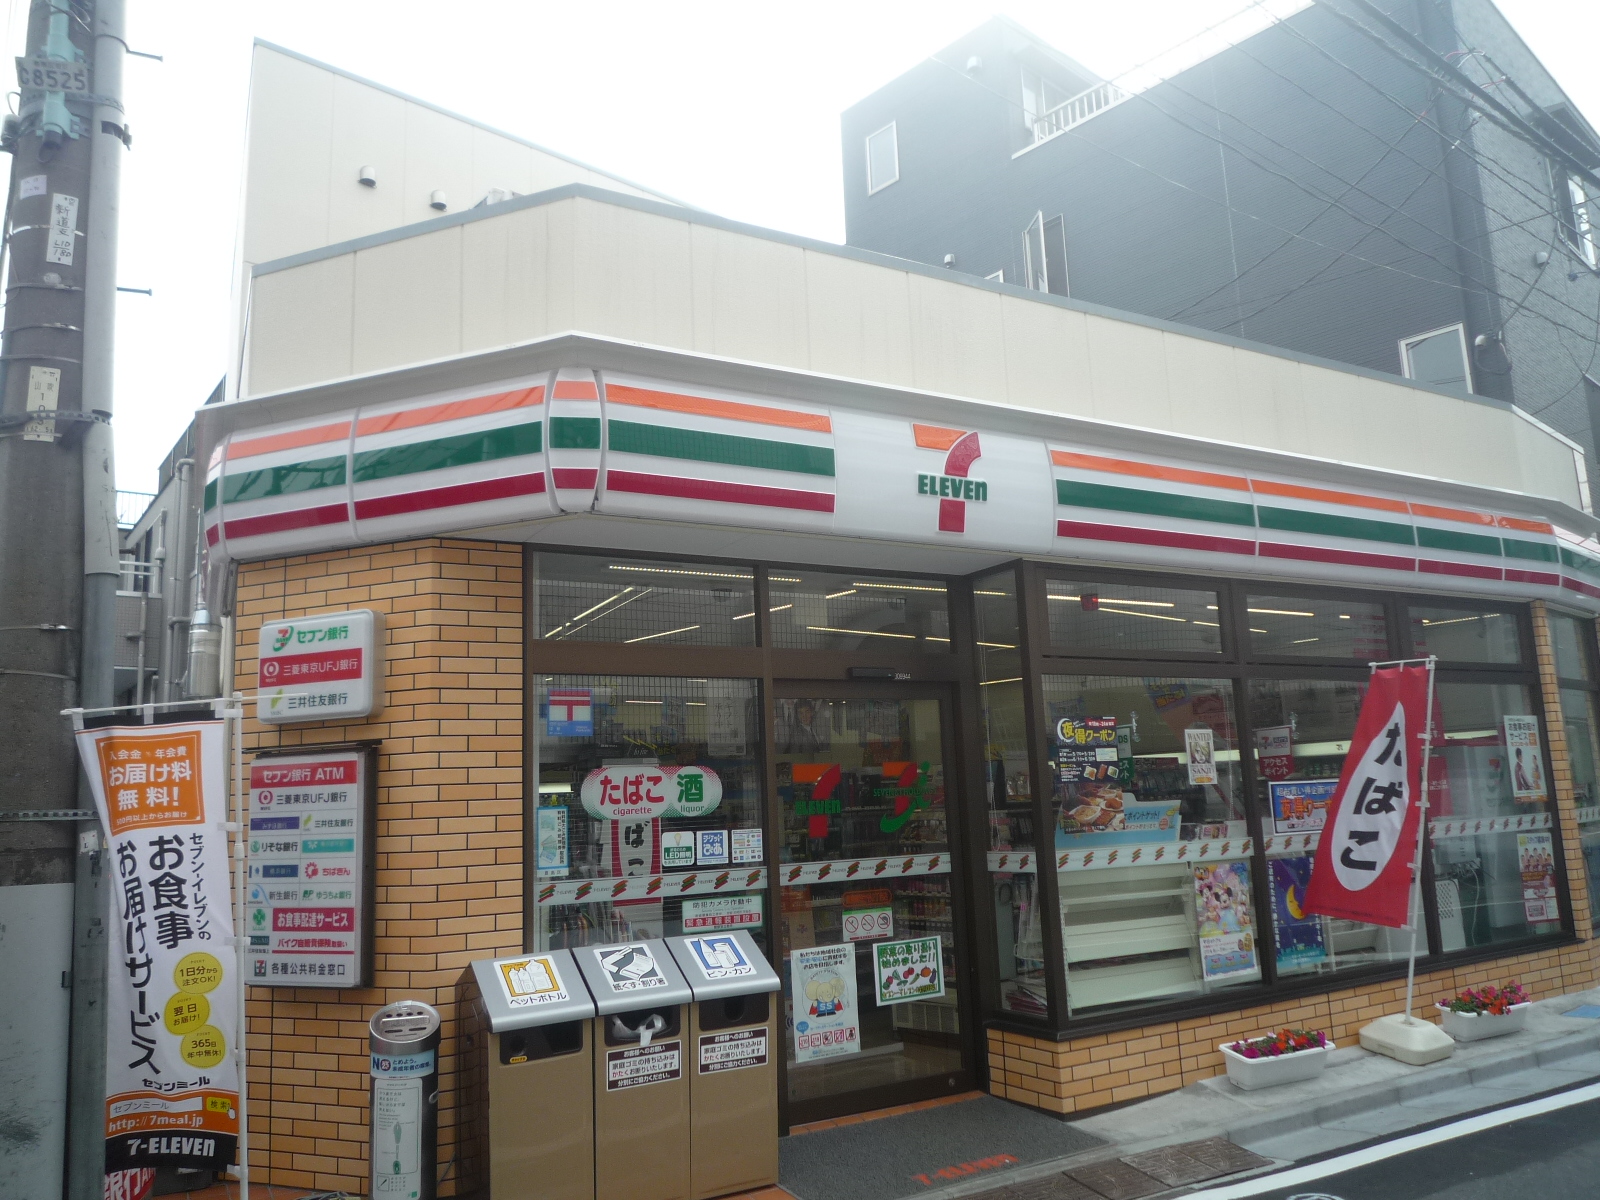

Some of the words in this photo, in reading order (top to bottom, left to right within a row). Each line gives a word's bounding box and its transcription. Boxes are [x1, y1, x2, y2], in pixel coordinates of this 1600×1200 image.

[917, 473, 988, 501] ELEVEN
[297, 625, 349, 644] セブン銀行
[283, 658, 358, 676] 三菱東京UFJ銀行
[288, 693, 348, 709] 三井住友銀行
[1263, 757, 1288, 766] アクセス
[109, 759, 192, 787] お届け料
[262, 768, 312, 784] セブン銀行
[314, 766, 345, 781] ATM
[1265, 767, 1289, 776] ポイント
[599, 773, 665, 805] たばこ
[677, 774, 703, 803] 酒
[276, 791, 348, 805] 三菱東京UFJ銀行
[1341, 722, 1404, 871] たばこ
[612, 805, 652, 816] cigarette
[680, 803, 704, 813] liquor
[314, 818, 354, 828] 三井住友銀行
[261, 841, 299, 852] りそな銀行
[665, 851, 692, 859] LED照明
[322, 867, 351, 876] ちばぎん
[148, 833, 195, 949] お食事
[269, 891, 298, 901] 新生銀行
[316, 890, 352, 900] ゆうちょ銀行
[692, 898, 753, 909] 防犯カメラ作動中
[277, 912, 349, 927] お食事配達サービス
[116, 839, 162, 1075] お届けサービス
[179, 965, 218, 977] 1日分から
[271, 962, 345, 975] 各種公共料金窓口
[510, 993, 567, 1006] ペットボトル
[191, 1038, 218, 1049] 365日
[704, 1040, 762, 1054] 家庭ゴミの持ち込みは
[624, 1046, 666, 1057] お客様へのお願い
[612, 1054, 675, 1070] 家庭ゴミの持ち込みは
[142, 1075, 211, 1092] セブンミール
[112, 1101, 170, 1113] セブンミール
[127, 1136, 216, 1157] 7-ELEVEN
